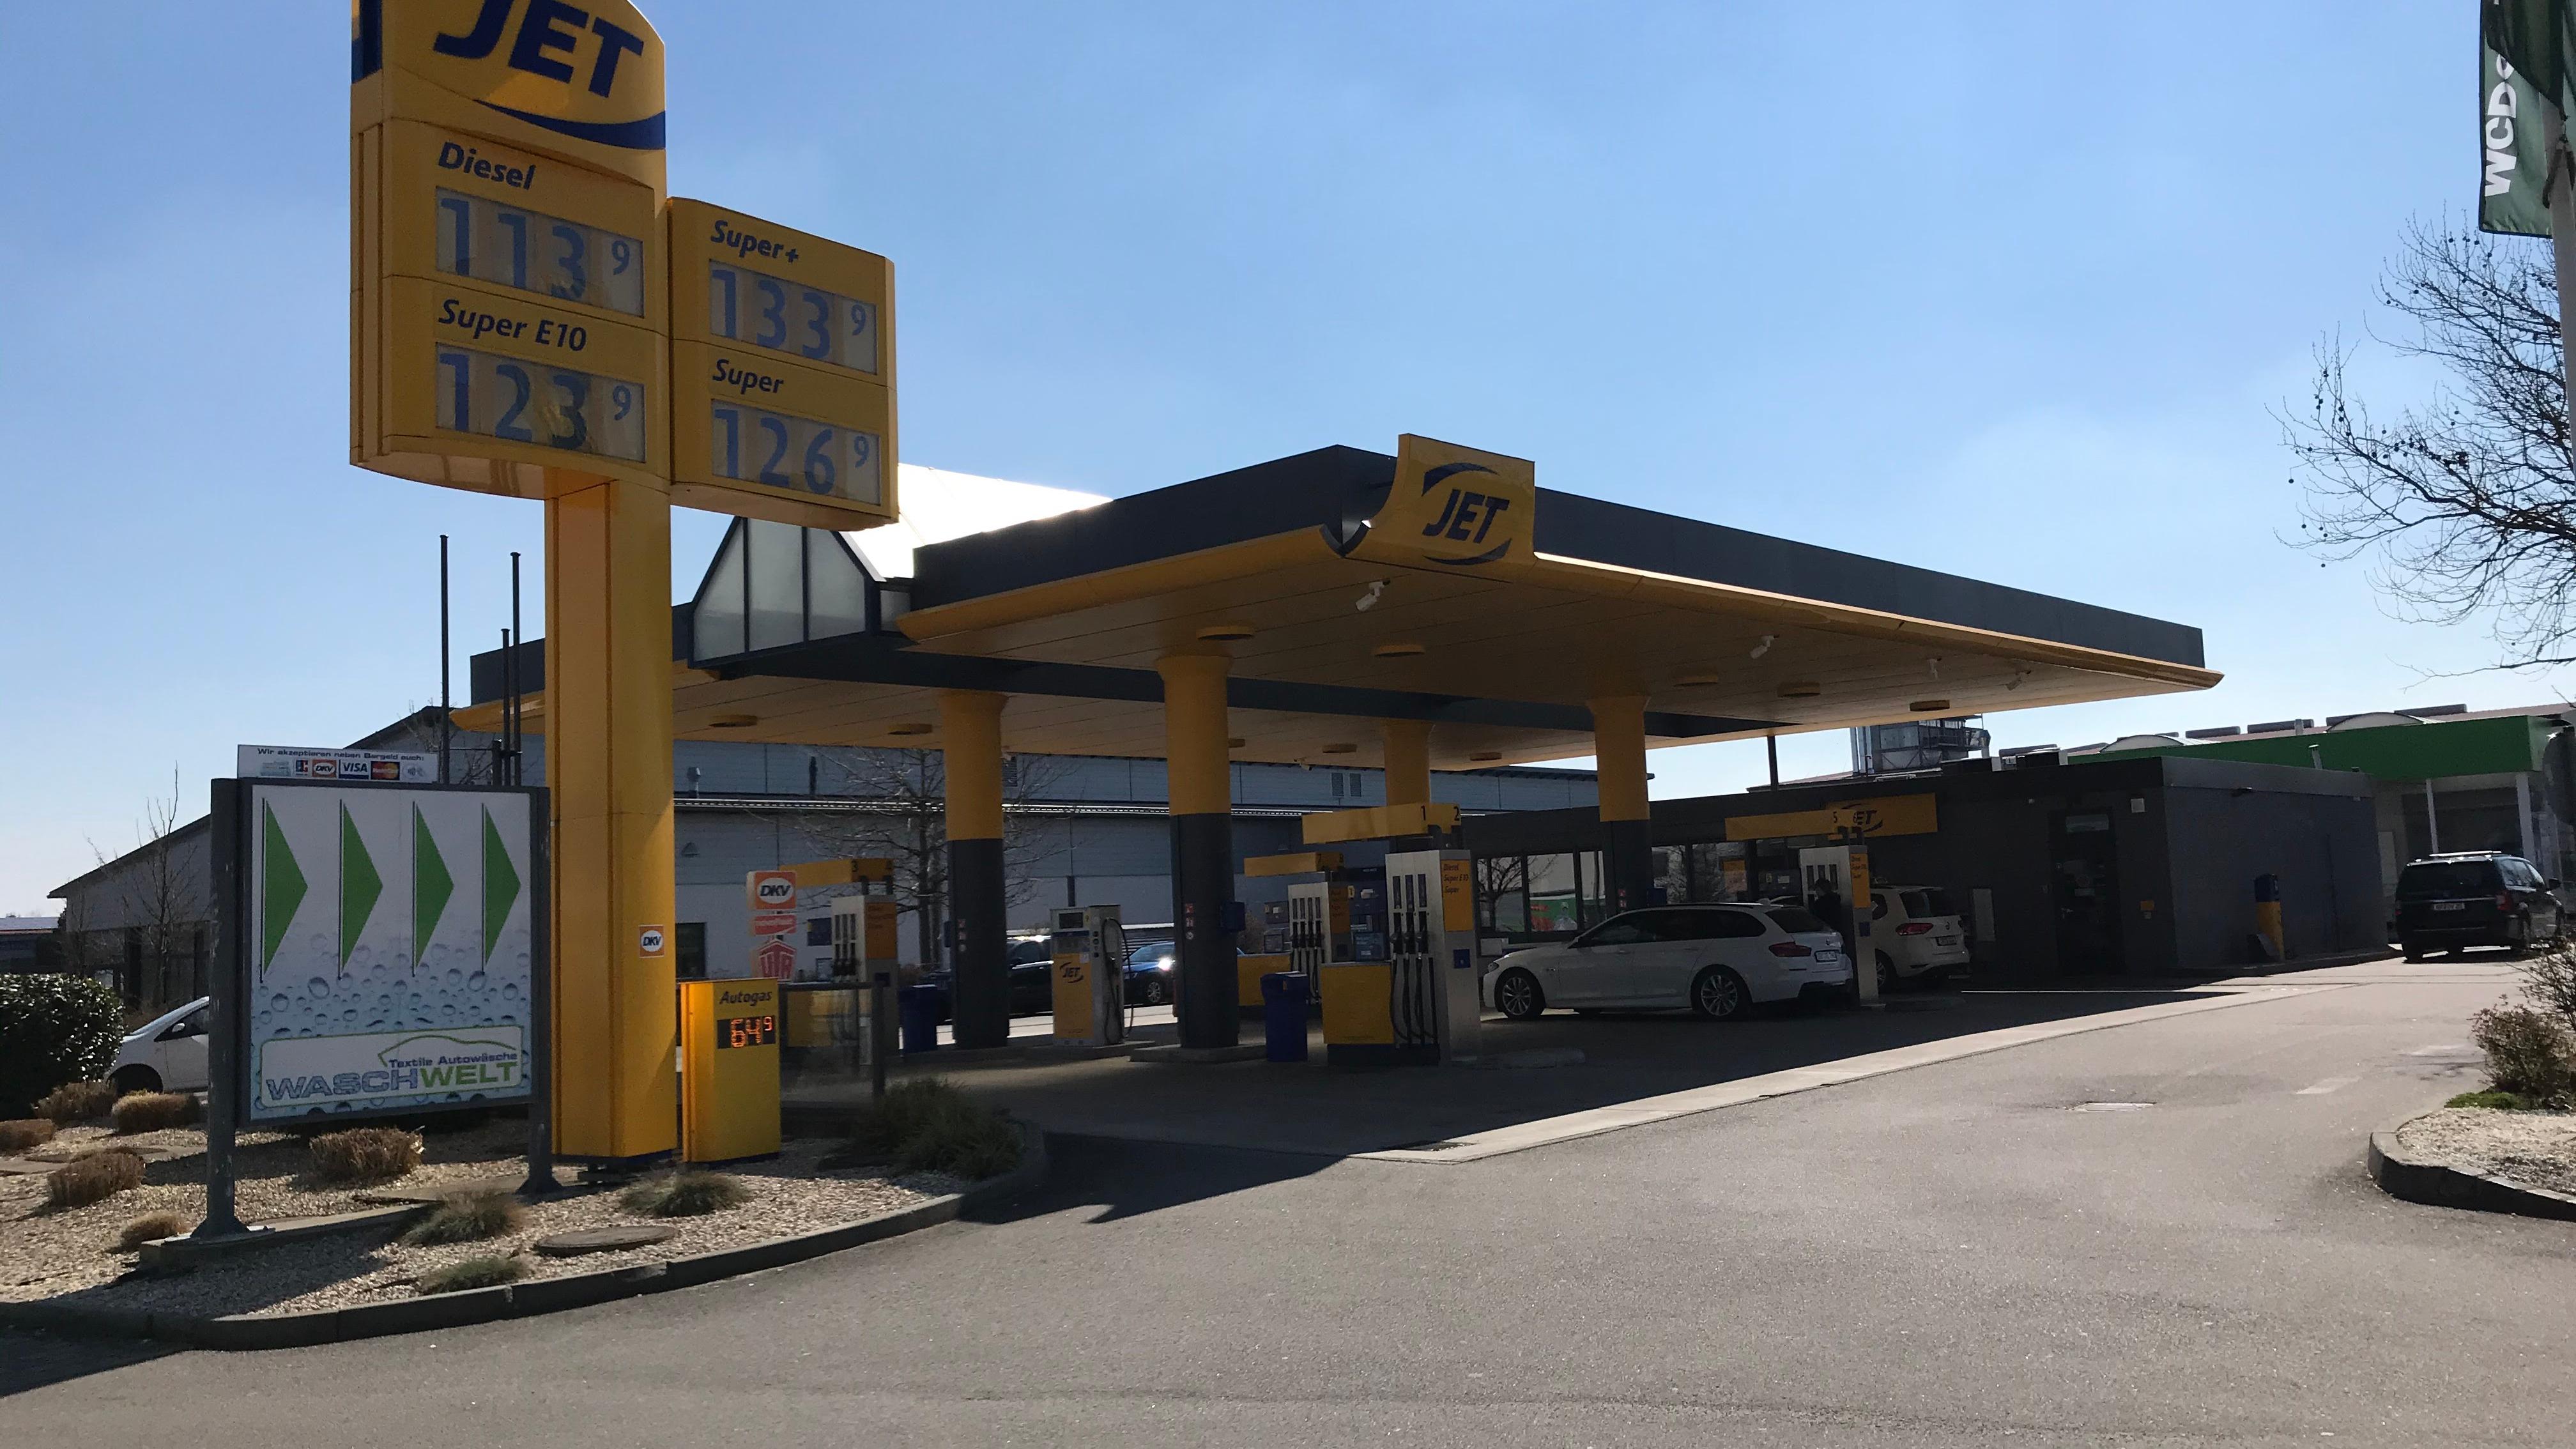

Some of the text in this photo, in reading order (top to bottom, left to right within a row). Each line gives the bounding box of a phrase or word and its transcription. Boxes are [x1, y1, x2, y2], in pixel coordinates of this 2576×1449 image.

[433, 0, 644, 98] JET
[438, 141, 536, 190] Diesel
[710, 220, 799, 264] Super+
[438, 299, 586, 352] Super E10
[712, 358, 784, 395] Super
[1422, 489, 1510, 544] JET
[344, 763, 368, 772] VISA
[1420, 804, 1426, 821] 1
[1453, 806, 1460, 822] 2
[852, 860, 859, 872] 3
[760, 884, 791, 897] DKV
[643, 935, 661, 946] DKV
[1062, 967, 1080, 977] JET
[719, 990, 772, 1007] Autogas
[388, 1052, 518, 1068] Textile Autowäsche
[266, 1061, 518, 1101] WASCHWELT
